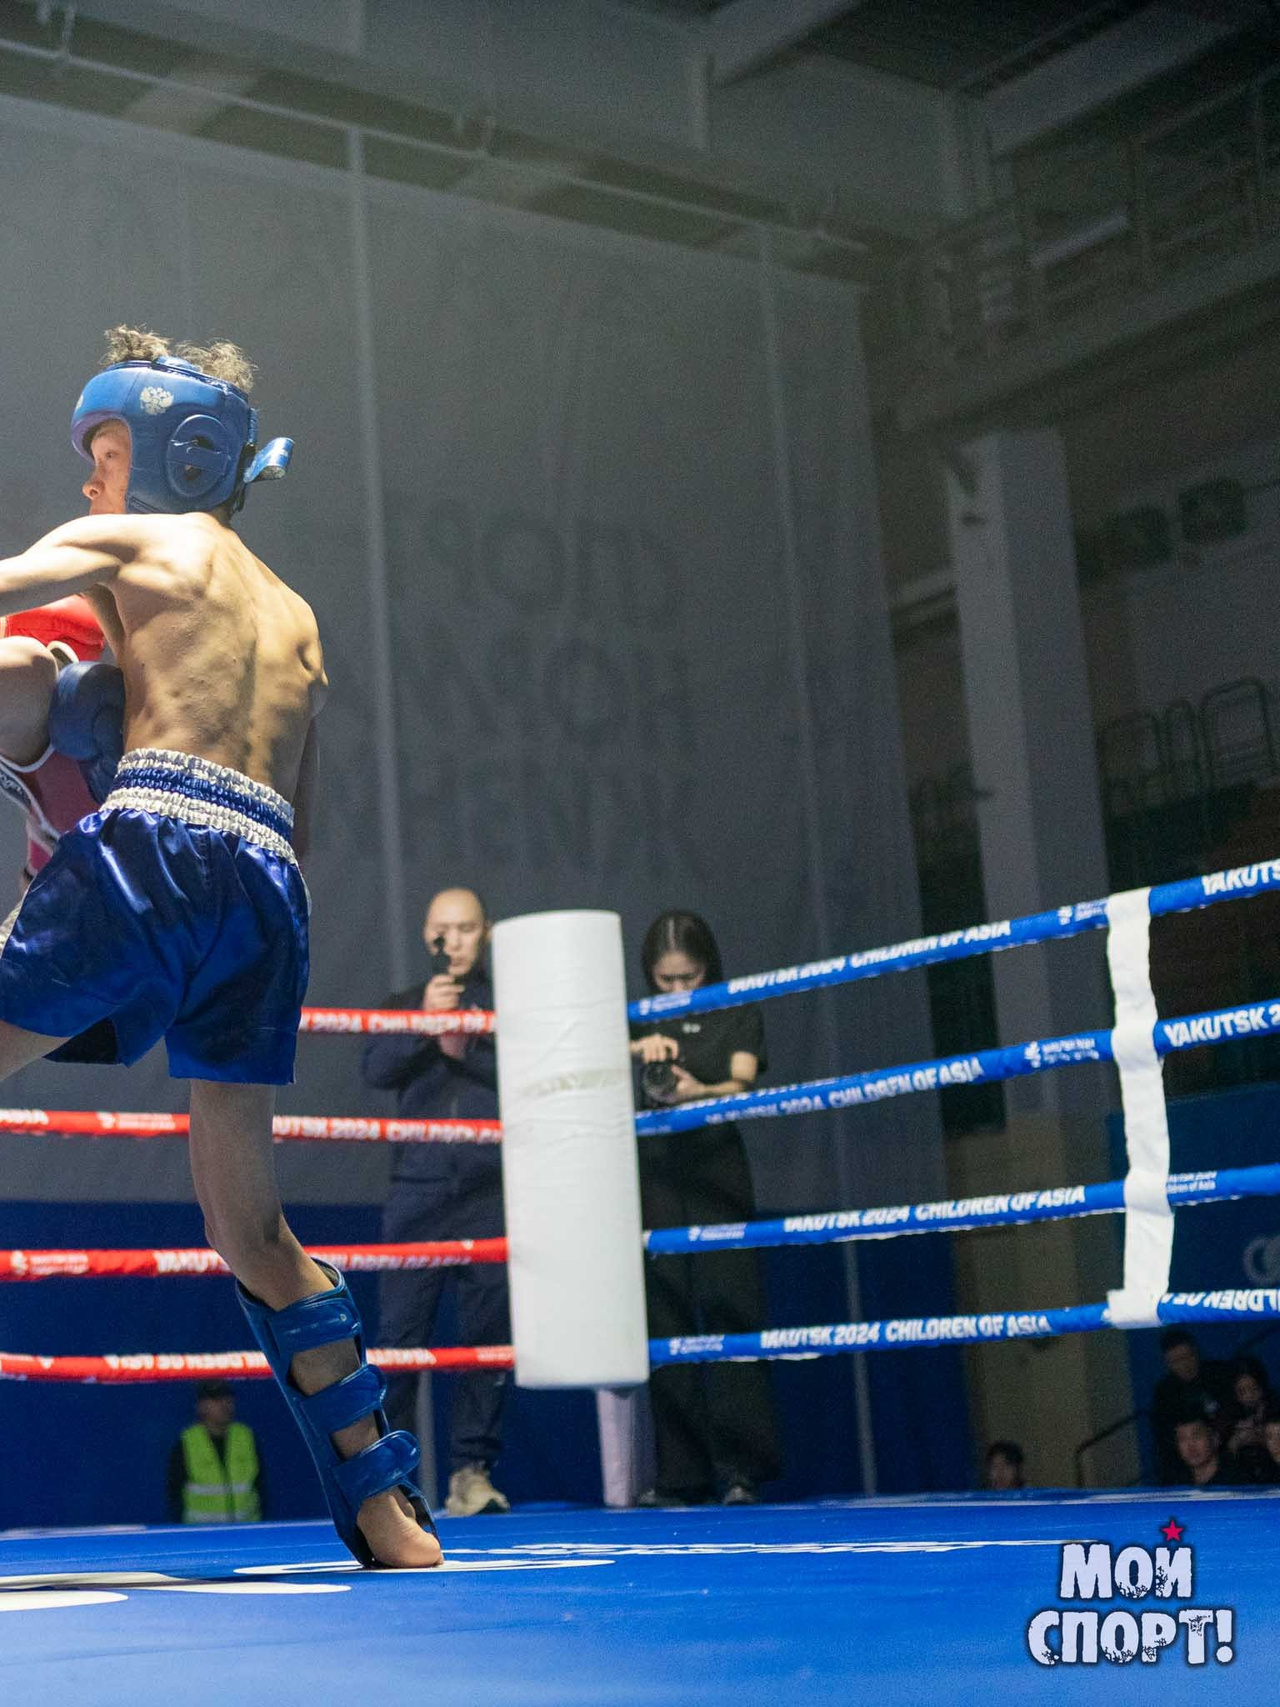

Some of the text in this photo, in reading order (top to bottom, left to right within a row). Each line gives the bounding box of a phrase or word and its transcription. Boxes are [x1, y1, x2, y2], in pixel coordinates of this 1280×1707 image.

[1163, 1006, 1270, 1048] YAKUTSK
[938, 1056, 987, 1083] ASIA
[913, 1197, 1011, 1221] CHILDREN
[1037, 1185, 1086, 1209] ASIA
[833, 1321, 881, 1345] 2024
[884, 1315, 980, 1342] CHILDREN
[978, 1315, 1005, 1337] OF
[1006, 1314, 1053, 1337] ASIA
